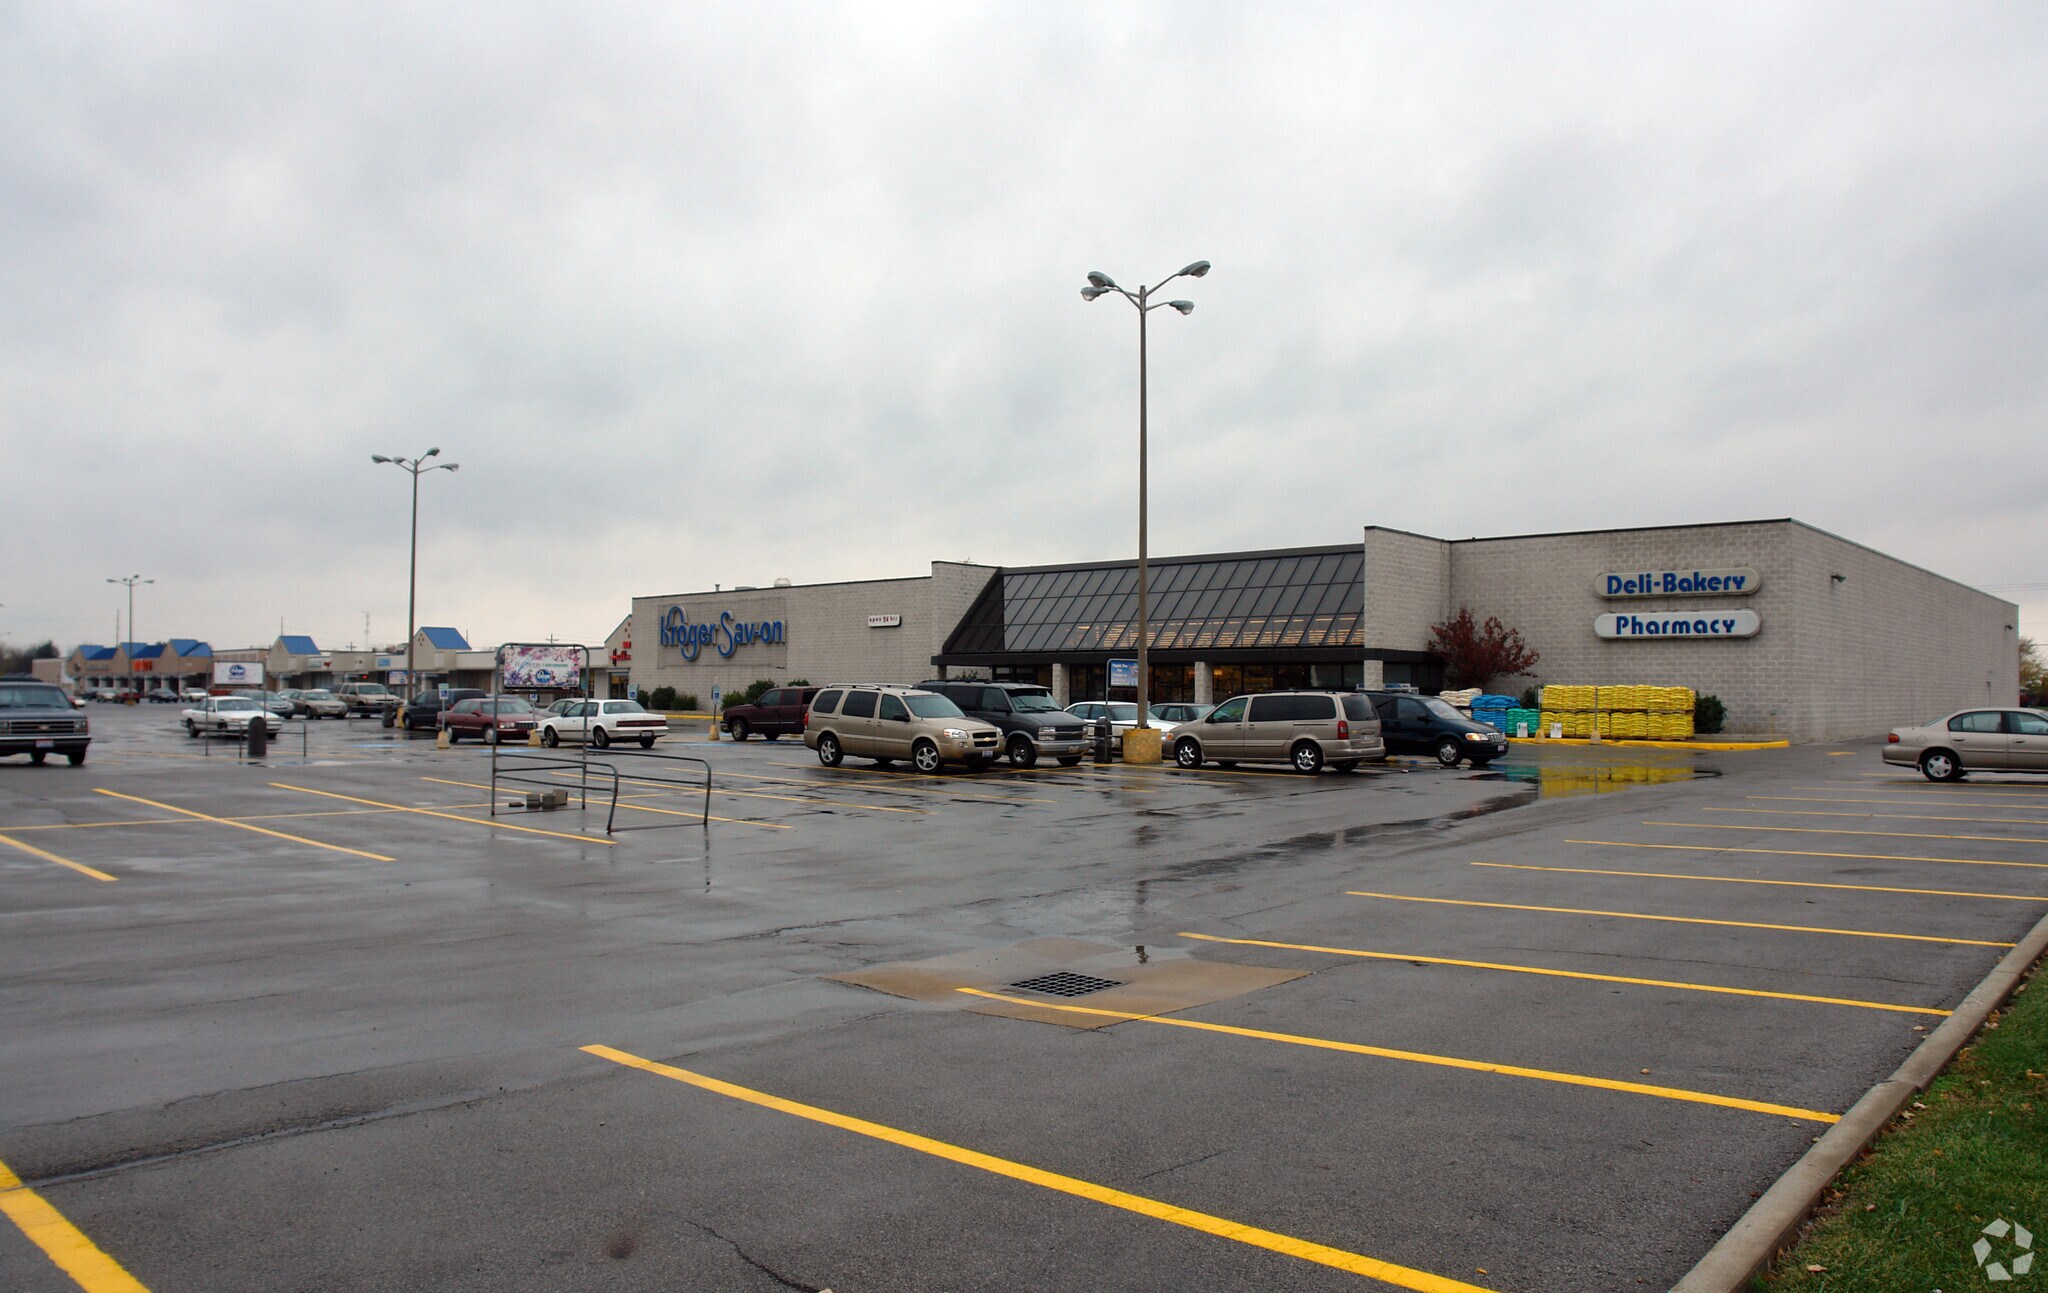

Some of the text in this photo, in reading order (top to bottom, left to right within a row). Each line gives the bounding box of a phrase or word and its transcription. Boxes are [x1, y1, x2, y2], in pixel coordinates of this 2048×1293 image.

[1607, 572, 1745, 594] Deli-Bakery
[660, 606, 786, 660] Kroger Sav-on
[1616, 616, 1735, 635] Pharmacy
